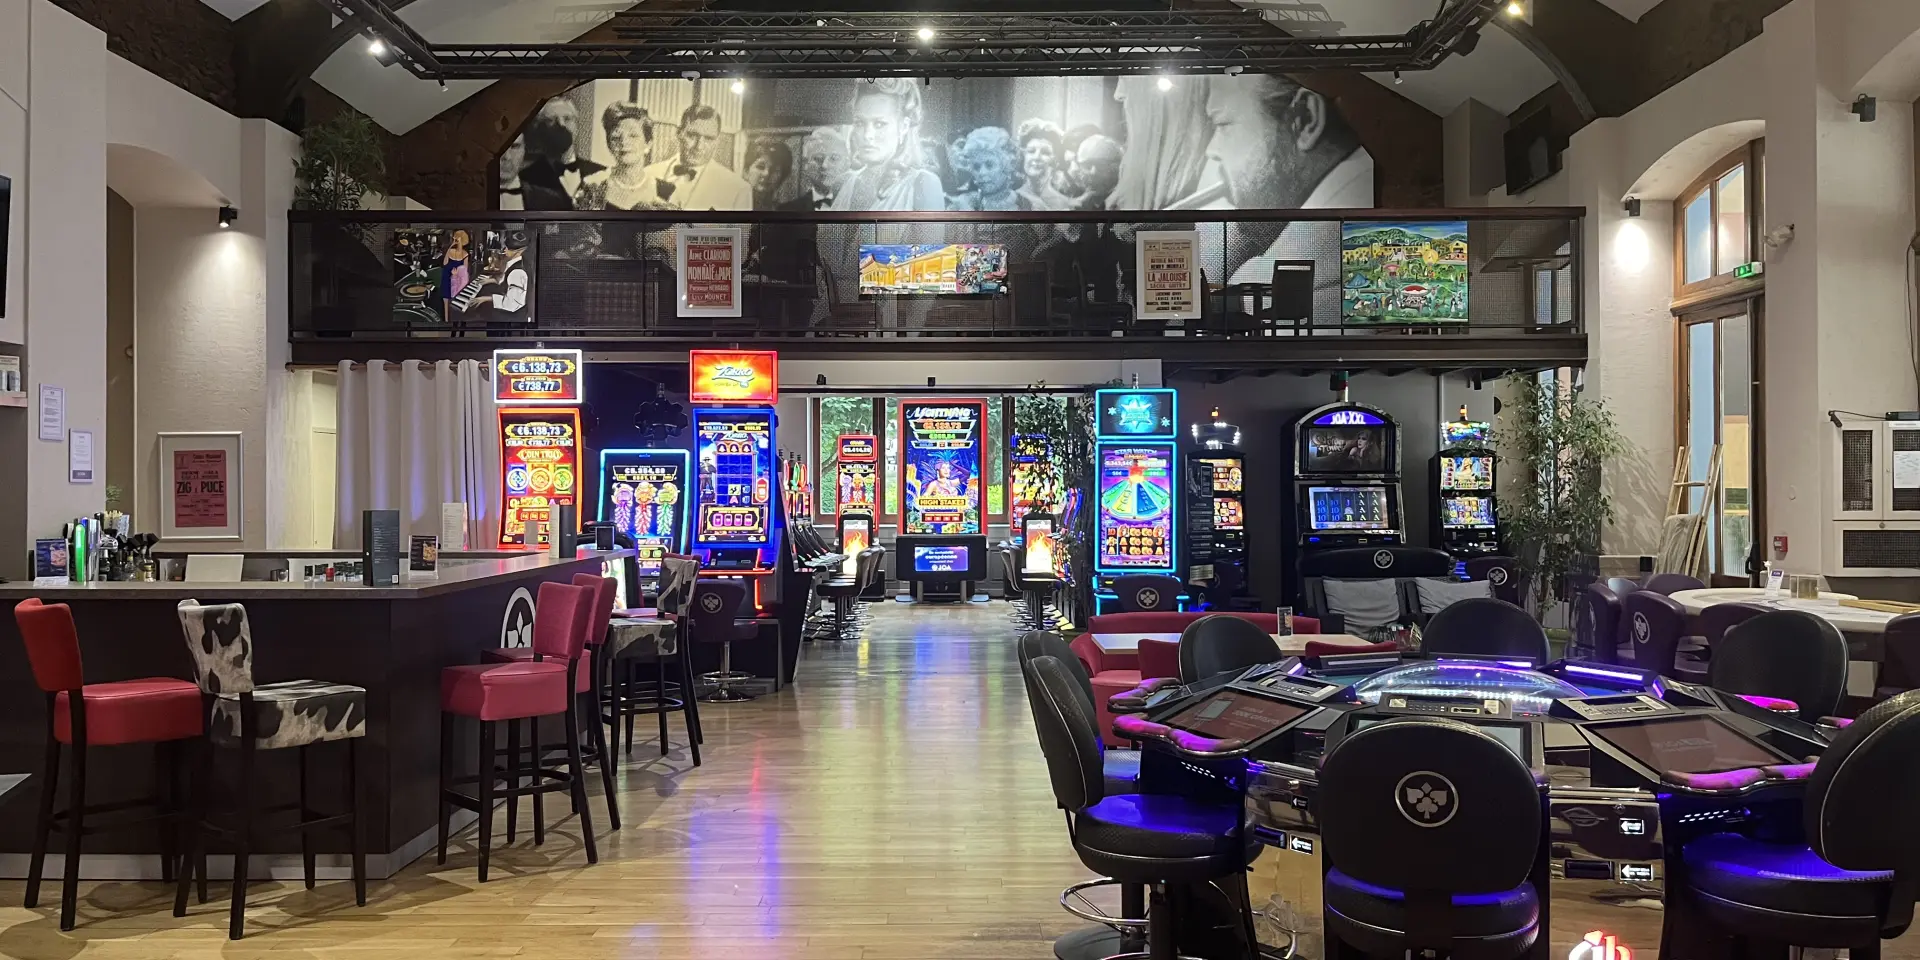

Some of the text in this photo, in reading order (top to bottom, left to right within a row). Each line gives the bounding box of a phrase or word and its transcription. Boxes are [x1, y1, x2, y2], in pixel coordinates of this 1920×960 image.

[1147, 272, 1188, 281] LA JALOUSIE
[511, 362, 562, 373] €6.138,73
[518, 381, 556, 391] €738,77
[914, 407, 971, 418] LIGHTNING
[517, 426, 561, 436] €6.138,73
[177, 481, 192, 494] ZIG
[201, 480, 224, 493] PUCE
